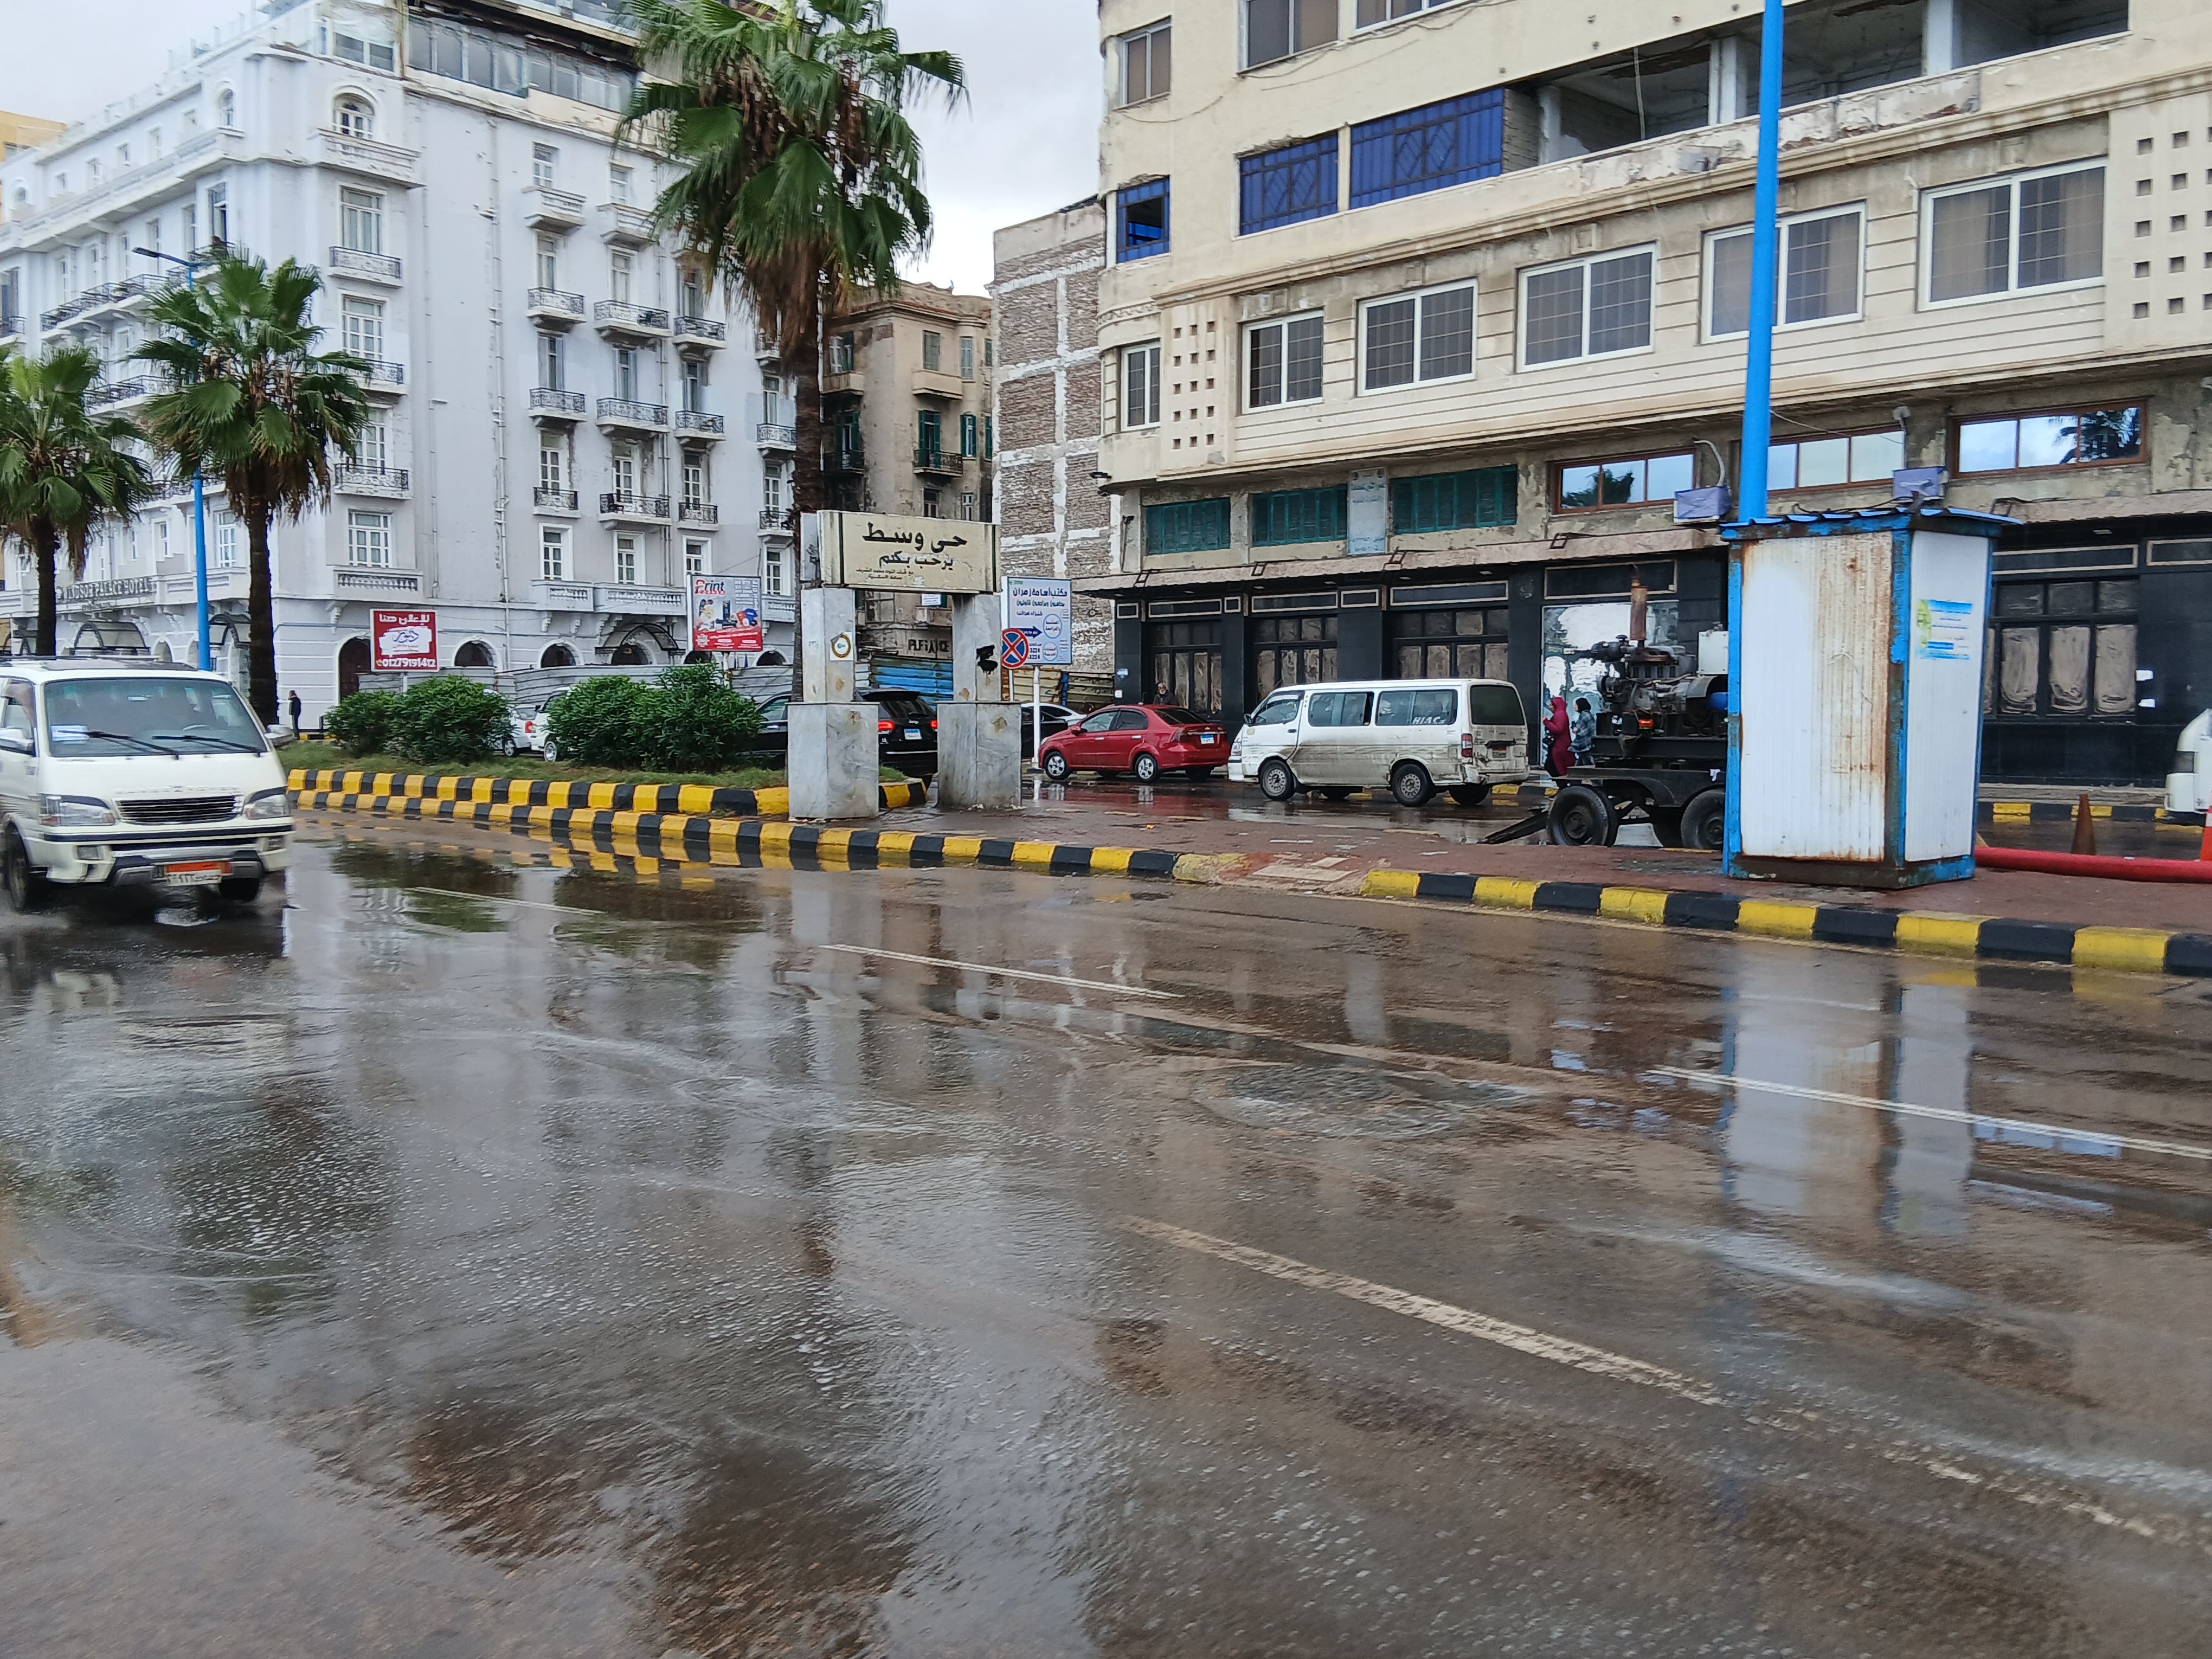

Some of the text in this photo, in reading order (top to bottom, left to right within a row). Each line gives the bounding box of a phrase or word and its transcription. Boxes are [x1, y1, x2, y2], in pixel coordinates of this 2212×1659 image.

[861, 522, 924, 551] وسط
[878, 550, 954, 571] يرحب بكم
[379, 613, 397, 622] هنا
